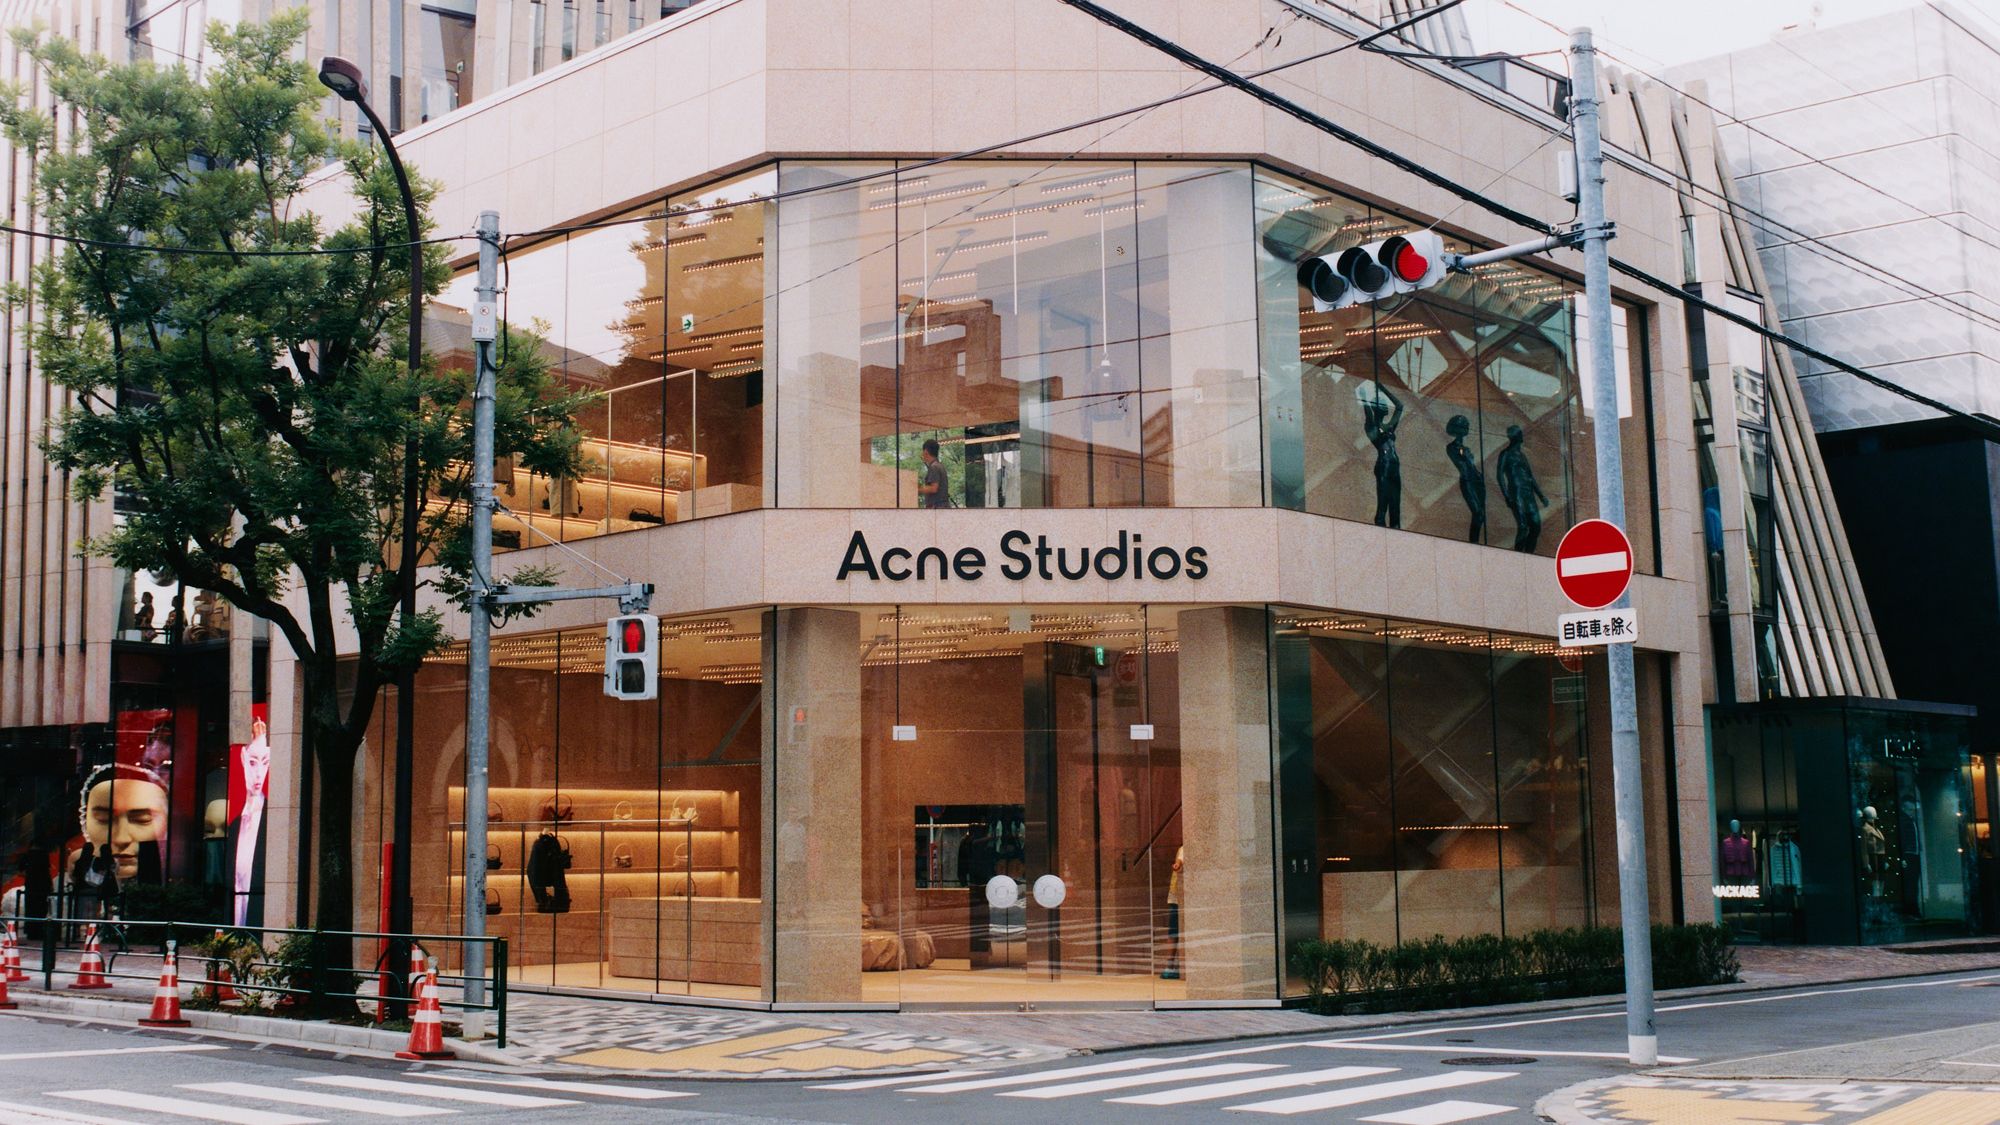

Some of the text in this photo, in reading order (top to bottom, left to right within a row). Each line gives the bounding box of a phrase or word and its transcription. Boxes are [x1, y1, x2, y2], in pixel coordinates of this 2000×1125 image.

[836, 529, 1209, 581] Acne Studios
[1563, 616, 1633, 640] 自転車を除く
